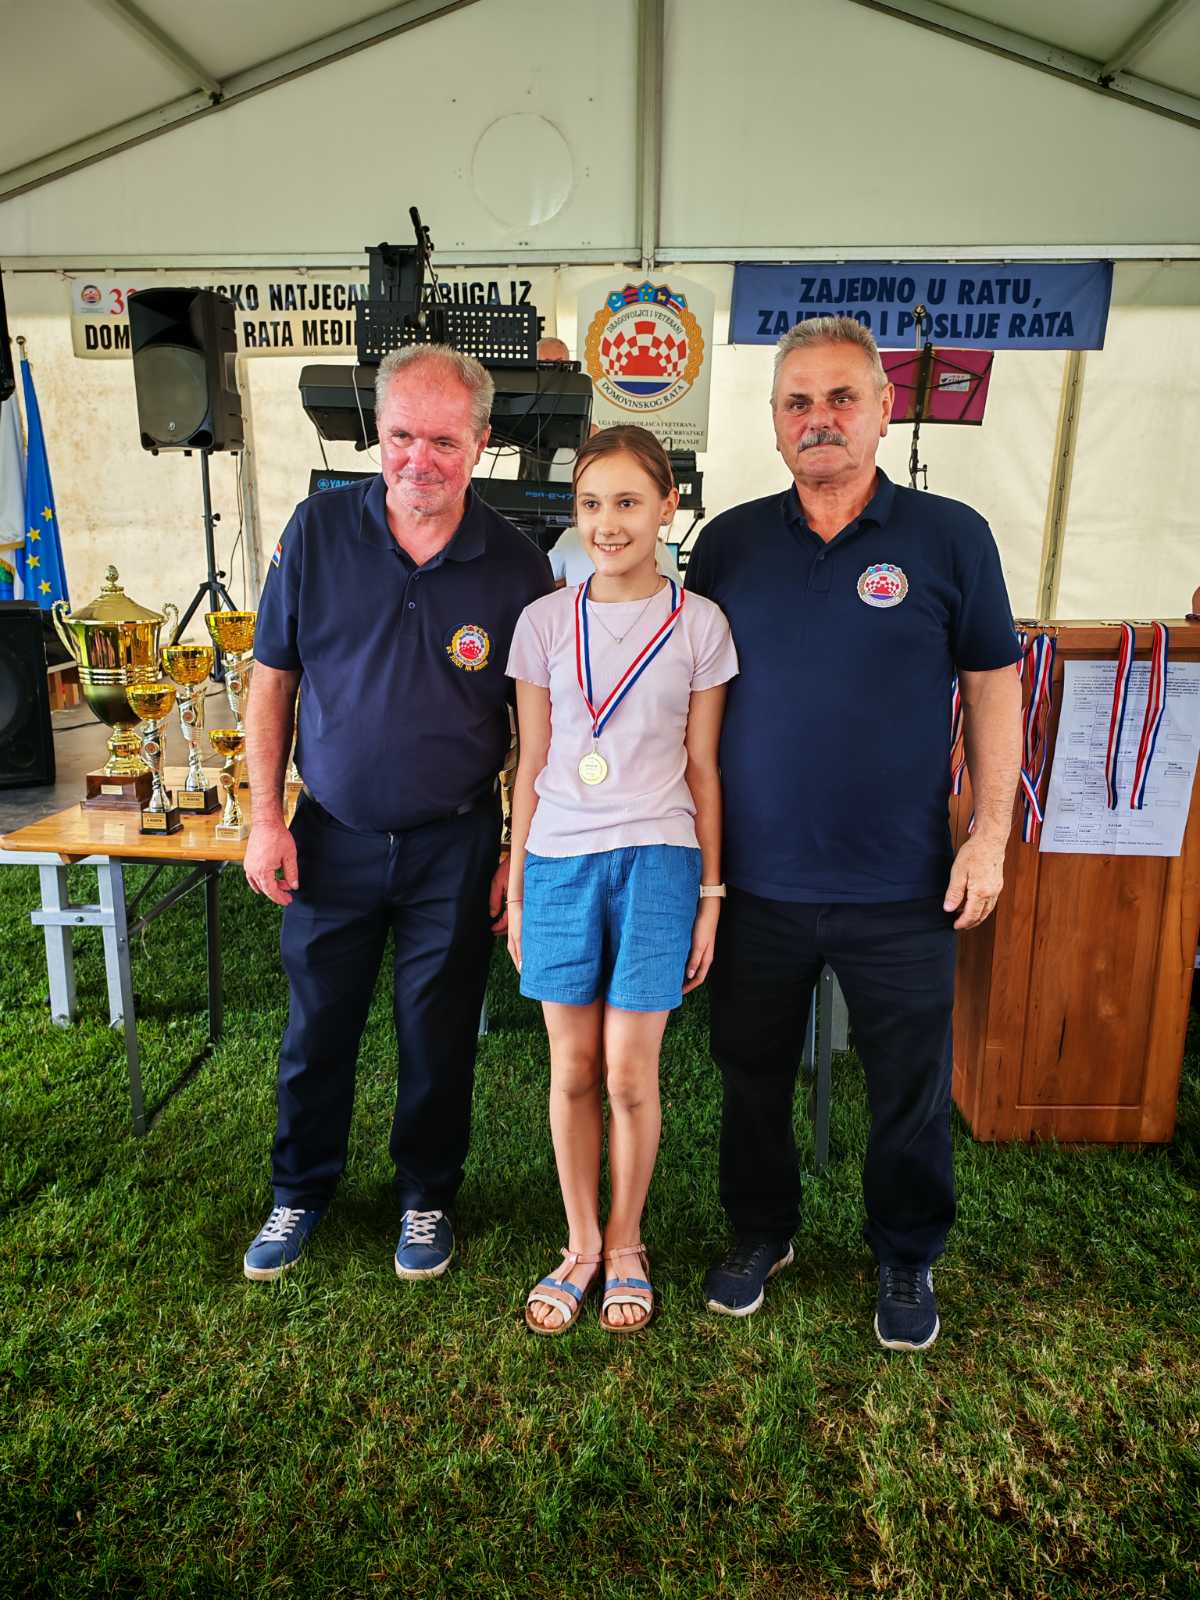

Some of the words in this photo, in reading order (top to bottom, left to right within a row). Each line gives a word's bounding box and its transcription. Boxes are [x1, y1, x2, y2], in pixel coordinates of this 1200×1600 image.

[510, 280, 533, 306] IZ
[798, 276, 916, 304] ZAJEDNO
[927, 278, 948, 305] U
[957, 278, 1042, 309] RATU,
[243, 320, 294, 347] RATA
[880, 311, 889, 337] I
[897, 311, 1000, 339] POSLIJE
[1008, 312, 1075, 338] RATA
[601, 382, 663, 409] DOMOVINSKOG
[663, 384, 685, 402] RATA
